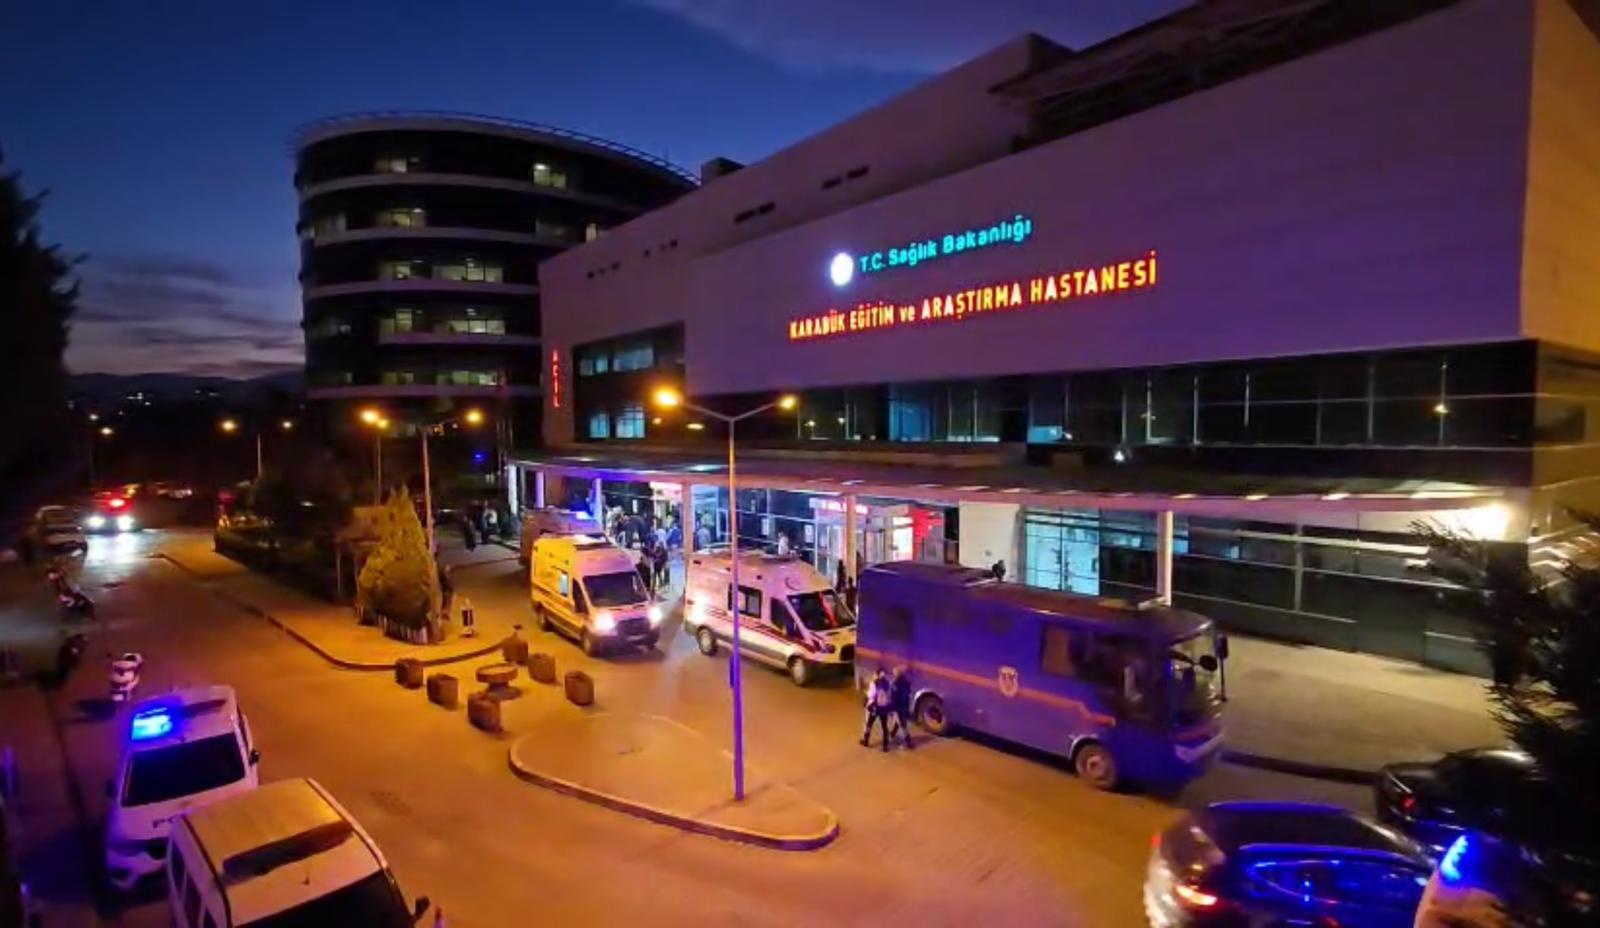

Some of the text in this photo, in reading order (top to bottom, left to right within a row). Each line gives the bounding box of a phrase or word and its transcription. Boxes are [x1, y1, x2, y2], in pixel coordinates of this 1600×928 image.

[888, 240, 938, 267] Sağlık
[942, 215, 1032, 254] Bakanlığı
[790, 250, 1157, 339] KARABÜK EĞİTİM ve ARAŞTIRMA HASTANESİ
